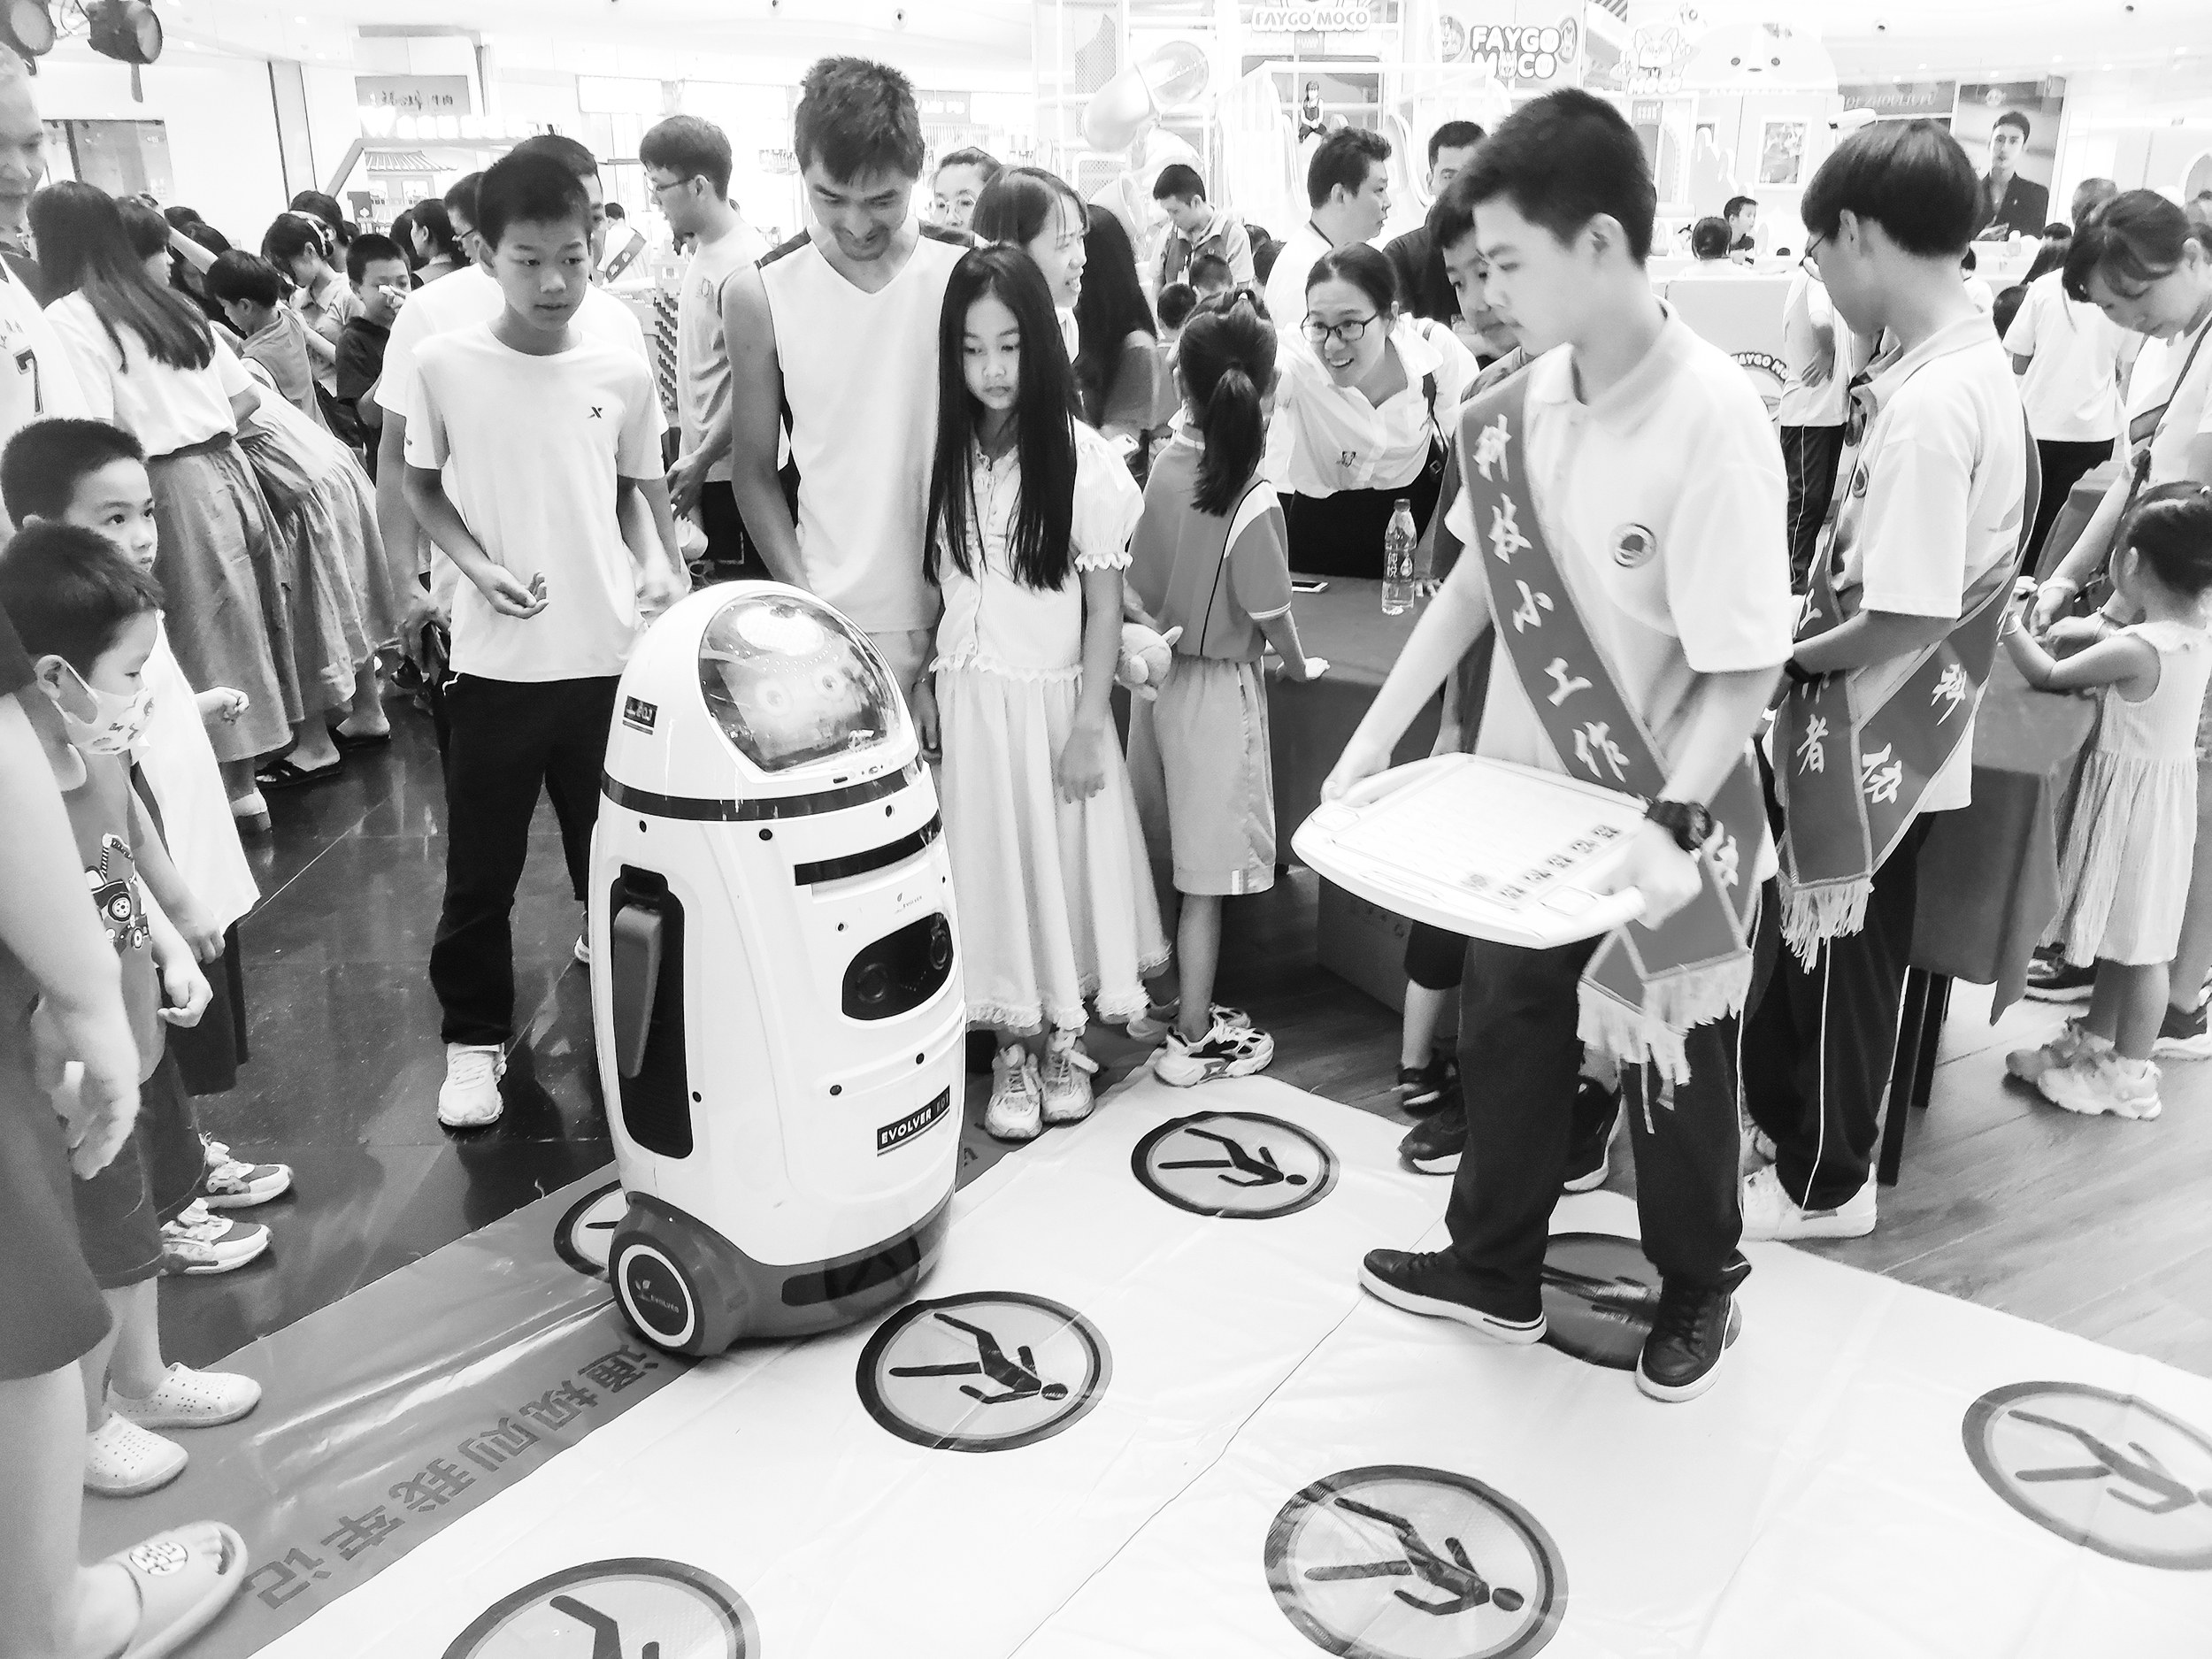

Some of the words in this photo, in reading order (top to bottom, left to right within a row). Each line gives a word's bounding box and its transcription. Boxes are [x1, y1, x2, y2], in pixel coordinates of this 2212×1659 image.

[1255, 12, 1311, 26] FAYGO
[1317, 12, 1368, 26] MOCO
[1469, 26, 1562, 54] FAYGO
[13, 346, 43, 417] 7
[881, 1108, 932, 1144] EVOLVER
[242, 1344, 660, 1609] 通规则我牢记
